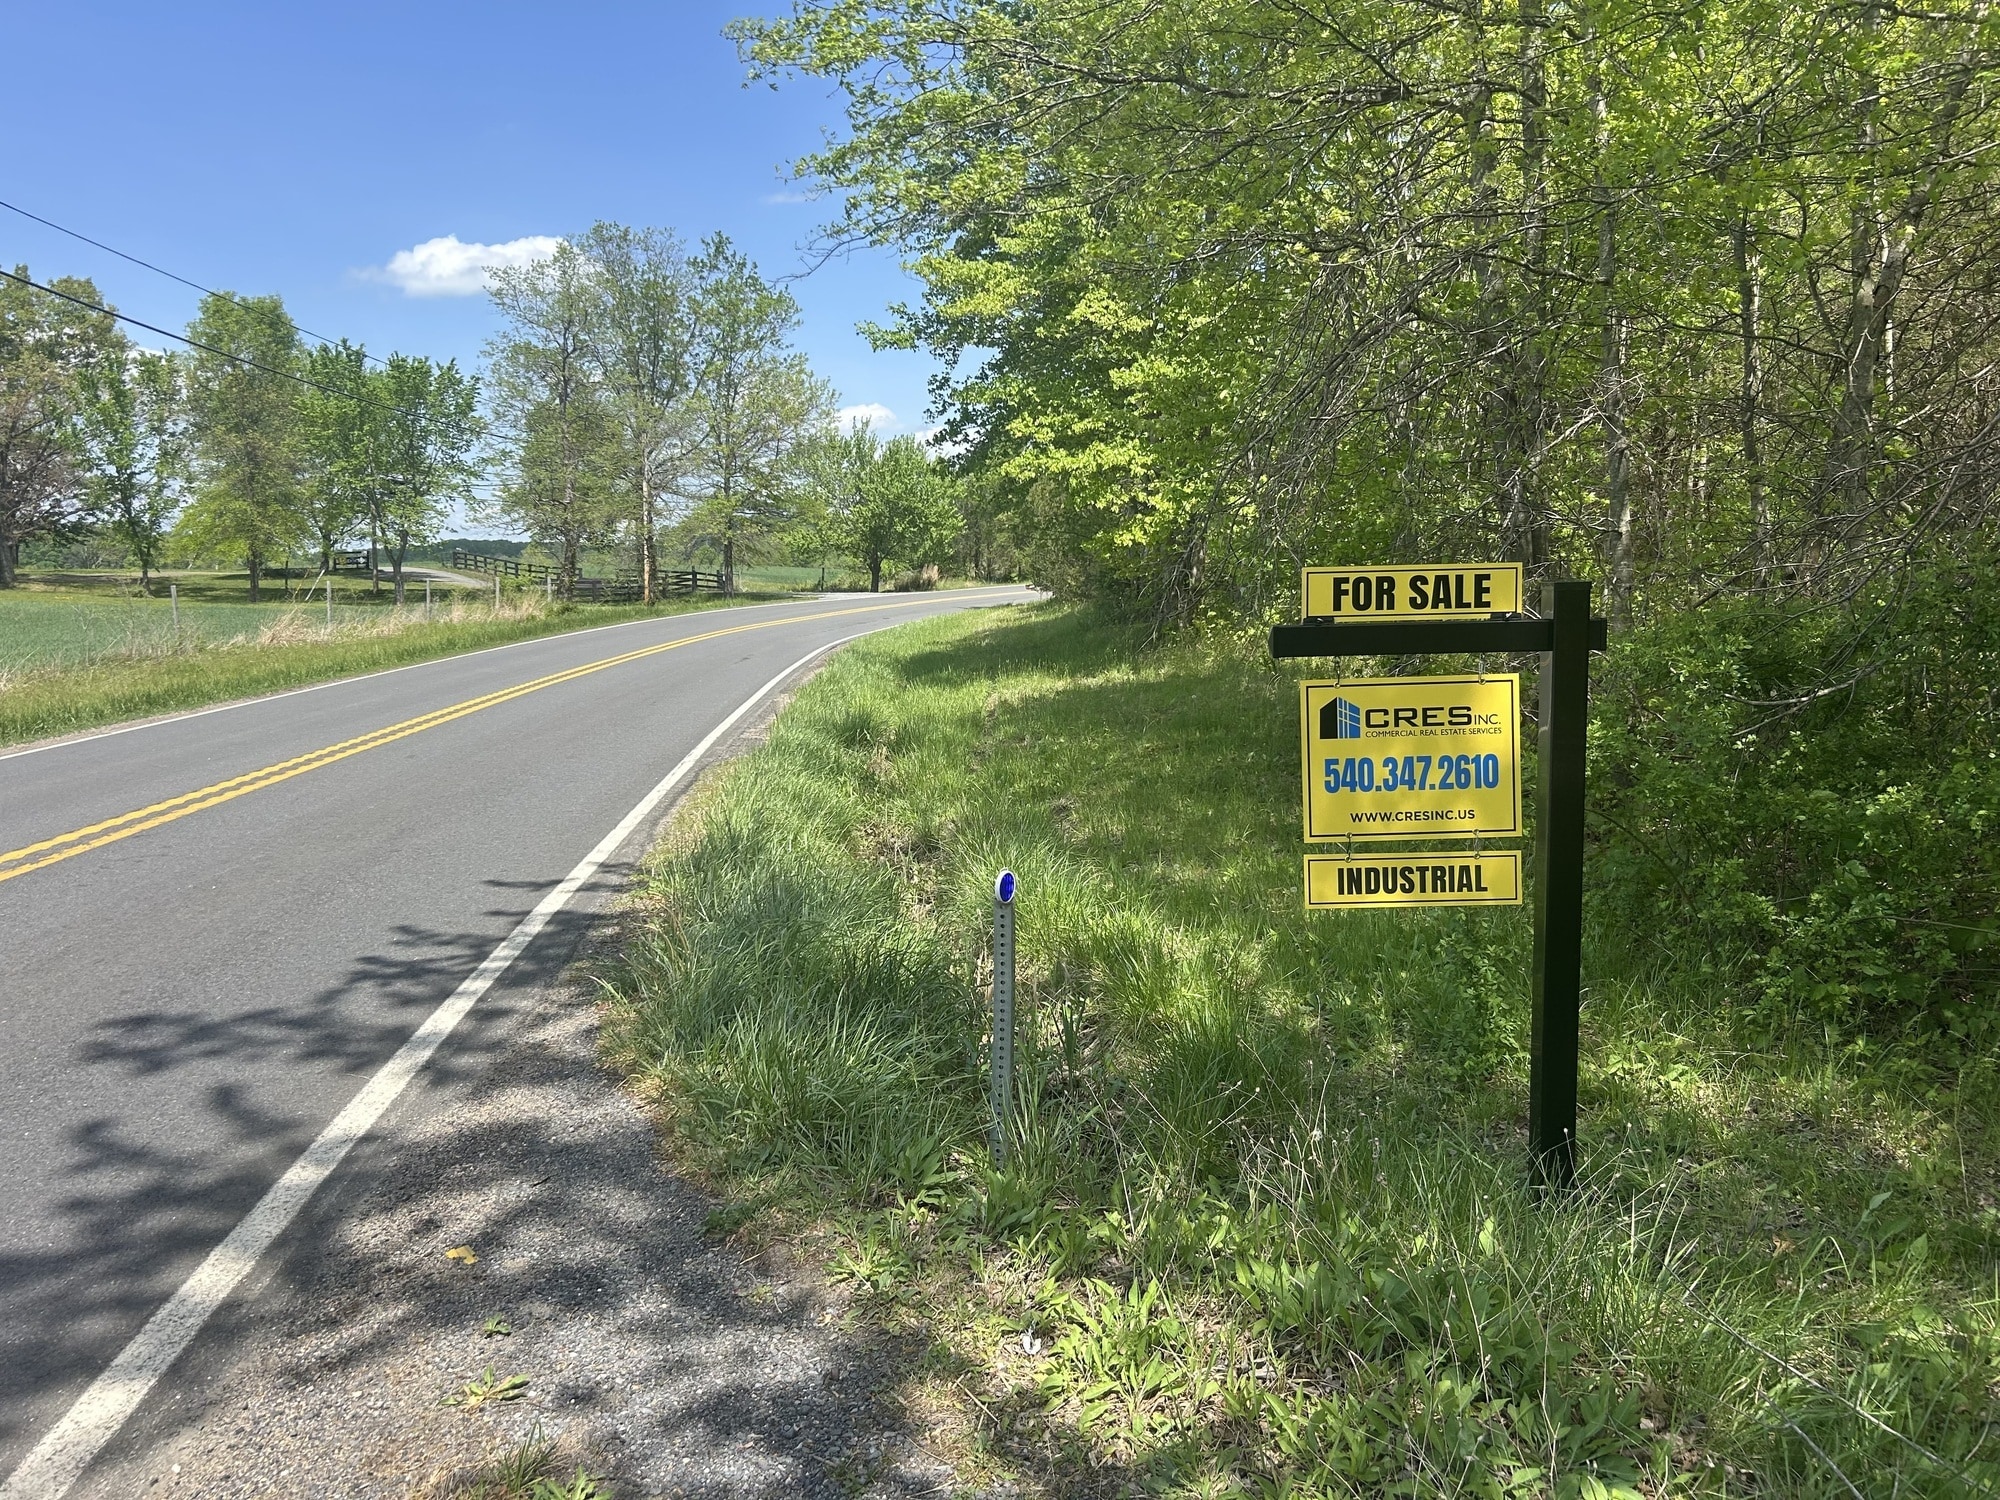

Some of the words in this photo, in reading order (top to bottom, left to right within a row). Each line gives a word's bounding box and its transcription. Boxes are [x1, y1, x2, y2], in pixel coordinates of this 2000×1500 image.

[1332, 576, 1396, 612] FOR
[1408, 573, 1491, 610] SALE
[1365, 706, 1472, 728] CRES
[1474, 713, 1502, 725] INC.
[1365, 729, 1418, 738] COMMERCIAL
[1419, 729, 1439, 737] REAL
[1440, 728, 1467, 736] ESTATE
[1468, 727, 1502, 735] SERVICES
[1324, 753, 1499, 793] 540.347.2610
[1350, 809, 1476, 823] WWW.CRESINC.US
[1337, 864, 1488, 895] INDUSTRIAL
